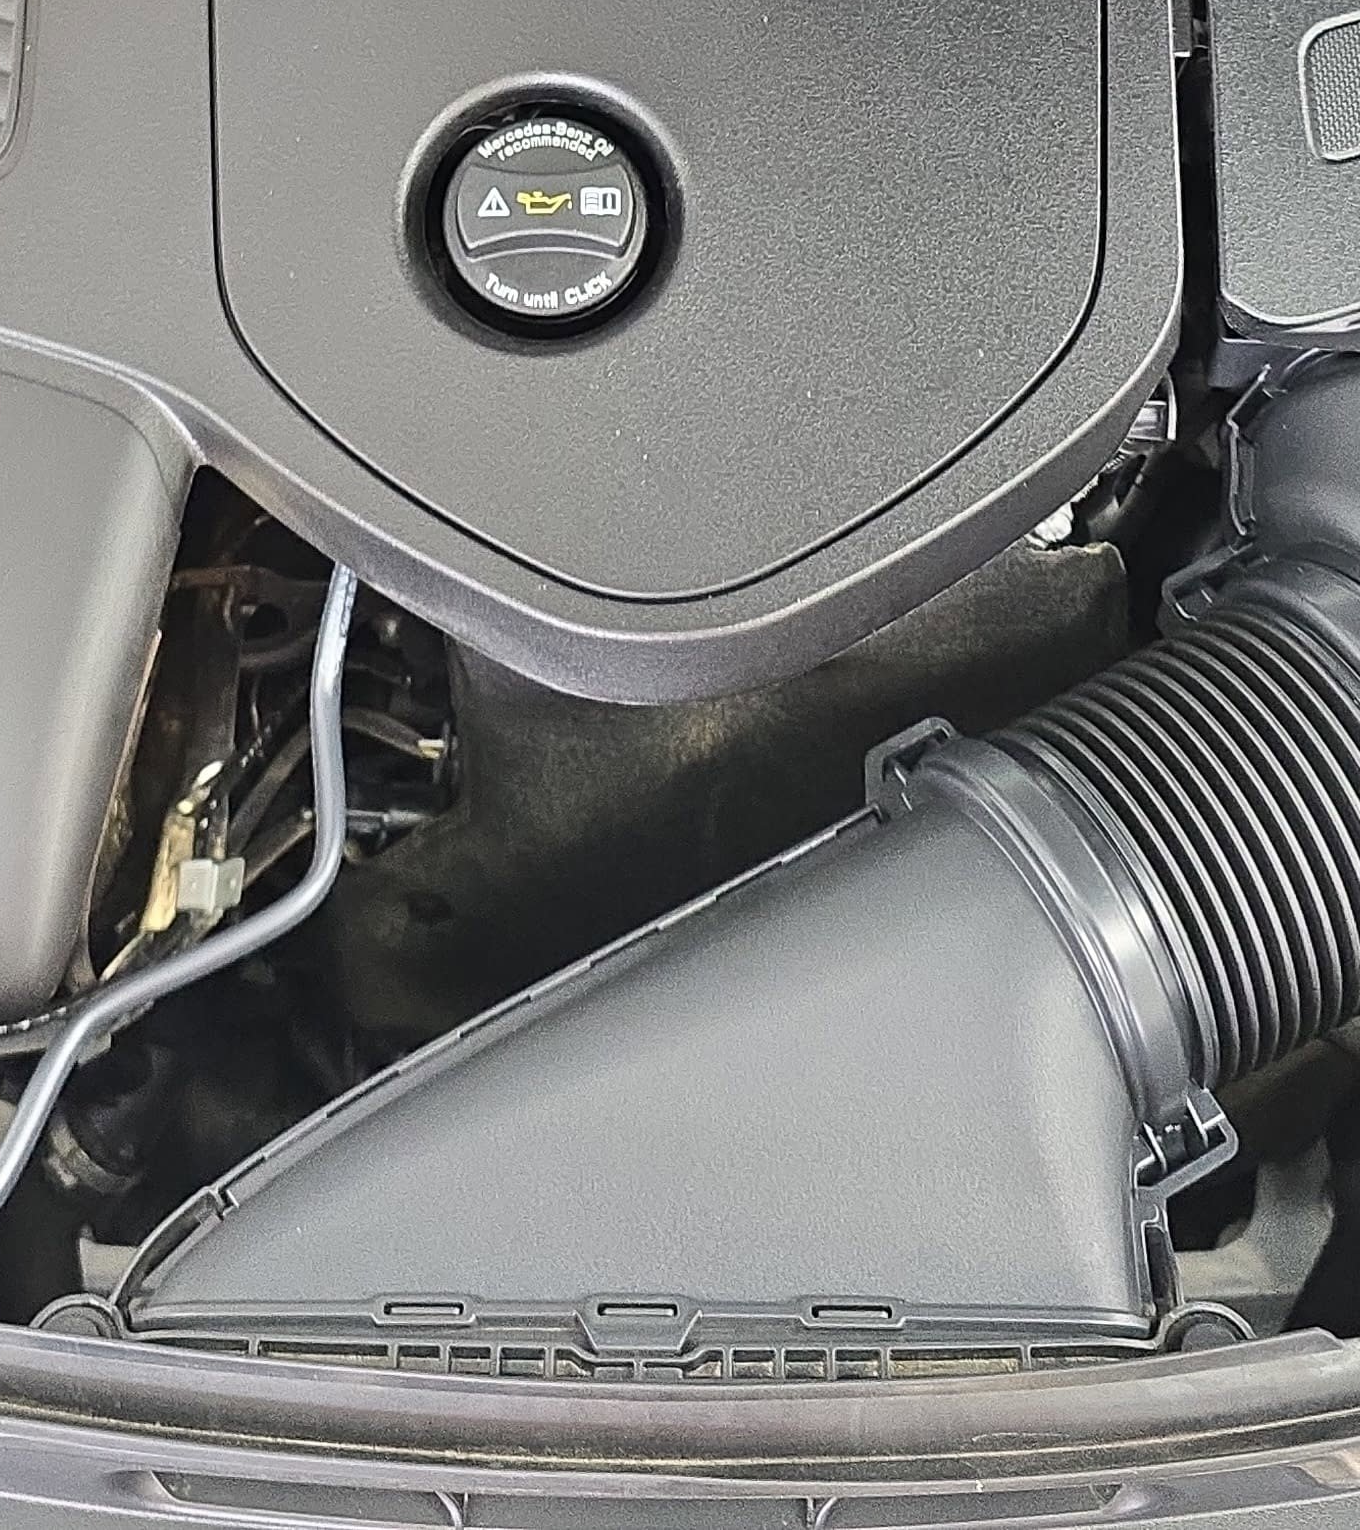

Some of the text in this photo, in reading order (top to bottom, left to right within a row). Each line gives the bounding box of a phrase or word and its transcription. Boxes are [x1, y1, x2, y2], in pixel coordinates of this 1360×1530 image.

[477, 121, 616, 159] Mercedes-Benz Oil
[497, 135, 599, 162] recommended
[485, 270, 612, 309] Turn until CLICK
